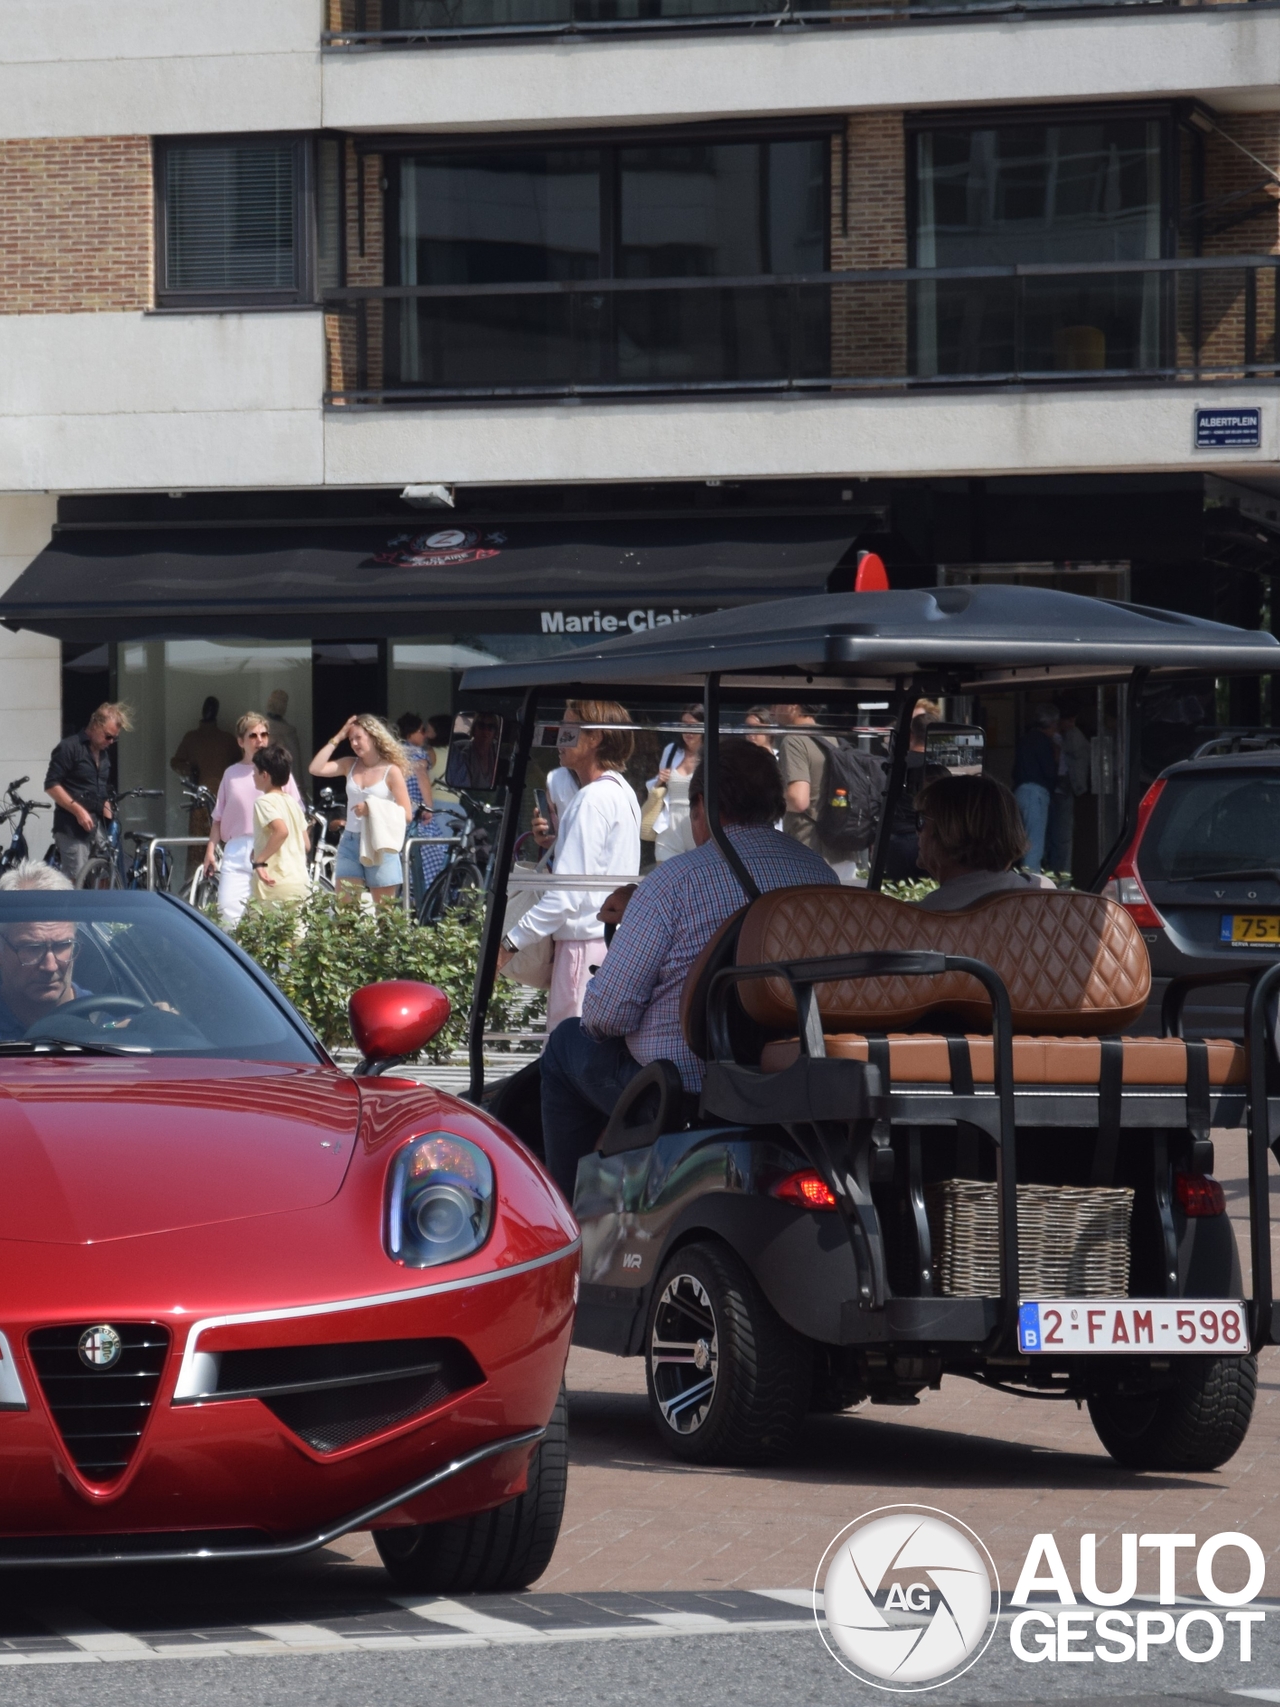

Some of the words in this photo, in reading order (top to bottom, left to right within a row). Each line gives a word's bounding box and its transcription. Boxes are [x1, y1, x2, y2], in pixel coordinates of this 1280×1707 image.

[1199, 417, 1258, 428] ALBERTPLEIN
[1241, 918, 1280, 938] 75-
[622, 1253, 642, 1269] WR
[1024, 1330, 1038, 1347] B
[1043, 1309, 1241, 1345] 2-FAM-598
